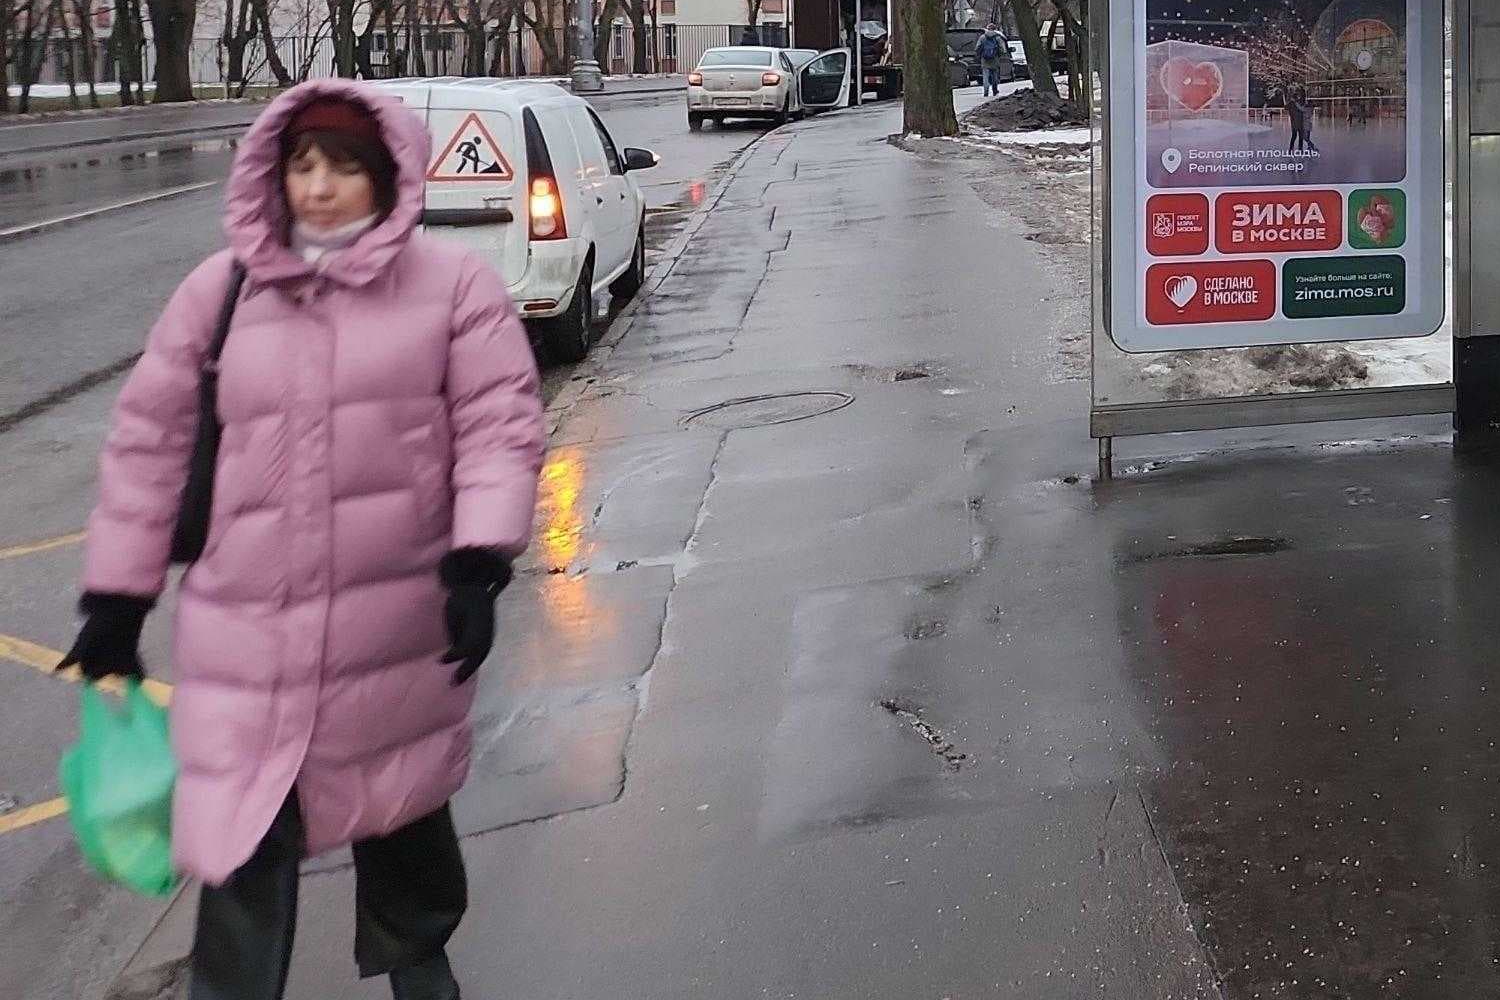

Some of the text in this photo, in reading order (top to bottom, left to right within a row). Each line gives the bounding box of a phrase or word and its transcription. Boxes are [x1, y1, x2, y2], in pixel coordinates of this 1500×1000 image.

[1188, 149, 1320, 160] Болотная площадь,
[1189, 162, 1304, 173] Репинский сквер
[1231, 202, 1326, 227] ЗИМА
[1232, 227, 1326, 242] В МОСКВЕ
[1204, 276, 1254, 292] СДЕЛАНО
[1204, 290, 1259, 306] В МОСКВЕ
[1295, 286, 1394, 300] zima.mos.ru
